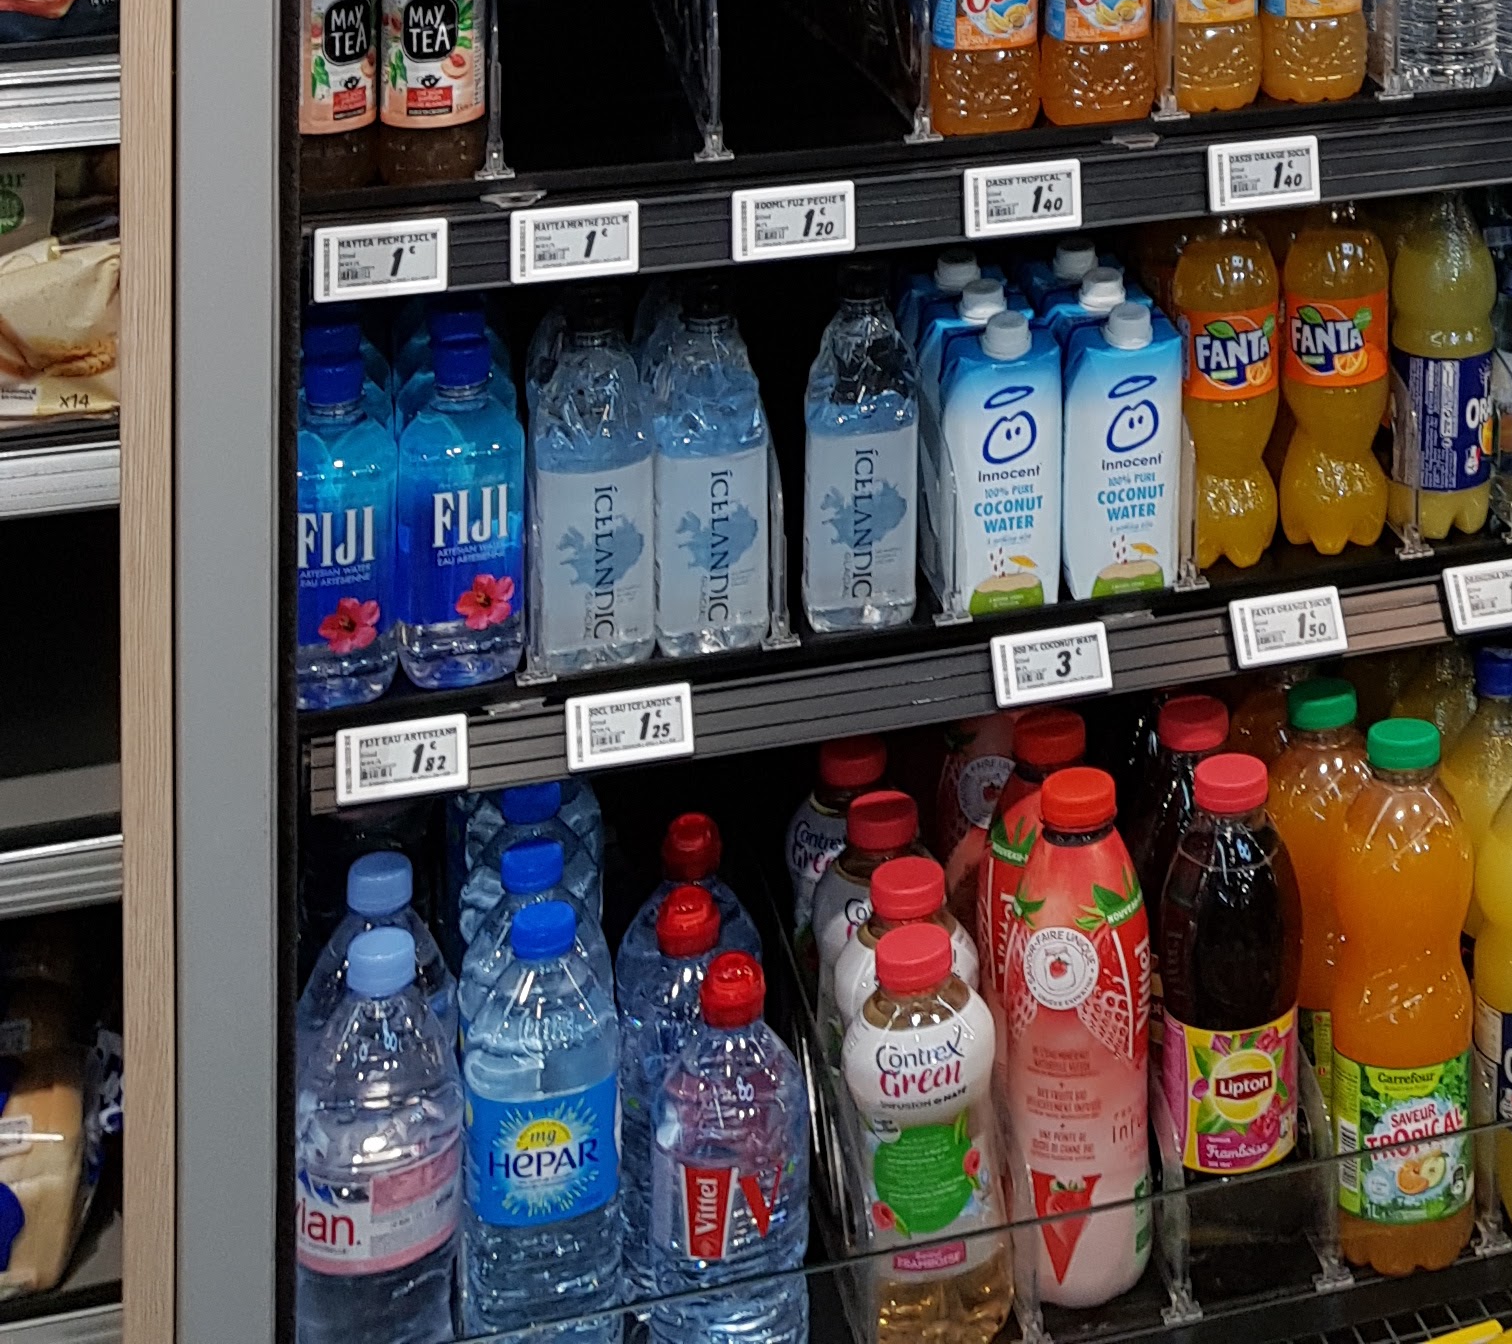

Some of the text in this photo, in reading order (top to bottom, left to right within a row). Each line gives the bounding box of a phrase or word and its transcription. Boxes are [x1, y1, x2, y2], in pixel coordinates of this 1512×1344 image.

[331, 5, 364, 29] MAY
[408, 4, 444, 30] MAY
[331, 30, 368, 57] TEA
[409, 25, 452, 53] TEA
[1016, 174, 1062, 185] TROPICAL
[1291, 319, 1364, 353] FANTA
[1195, 331, 1271, 370] FANTA
[1101, 451, 1163, 471] innocent
[977, 465, 1042, 483] innocent
[1097, 484, 1165, 505] COCONUT
[432, 484, 509, 549] FIJI
[973, 497, 1043, 517] COCONUT
[1106, 503, 1156, 522] WATER
[983, 514, 1035, 534] WATER
[879, 1060, 961, 1099] Green
[1219, 1072, 1273, 1097] Lipton
[1376, 1068, 1436, 1085] Carrefour
[1390, 1104, 1437, 1129] SAVEUR
[528, 1129, 556, 1147] my
[1205, 1142, 1269, 1163] Framboise
[694, 1175, 718, 1236] Vittel
